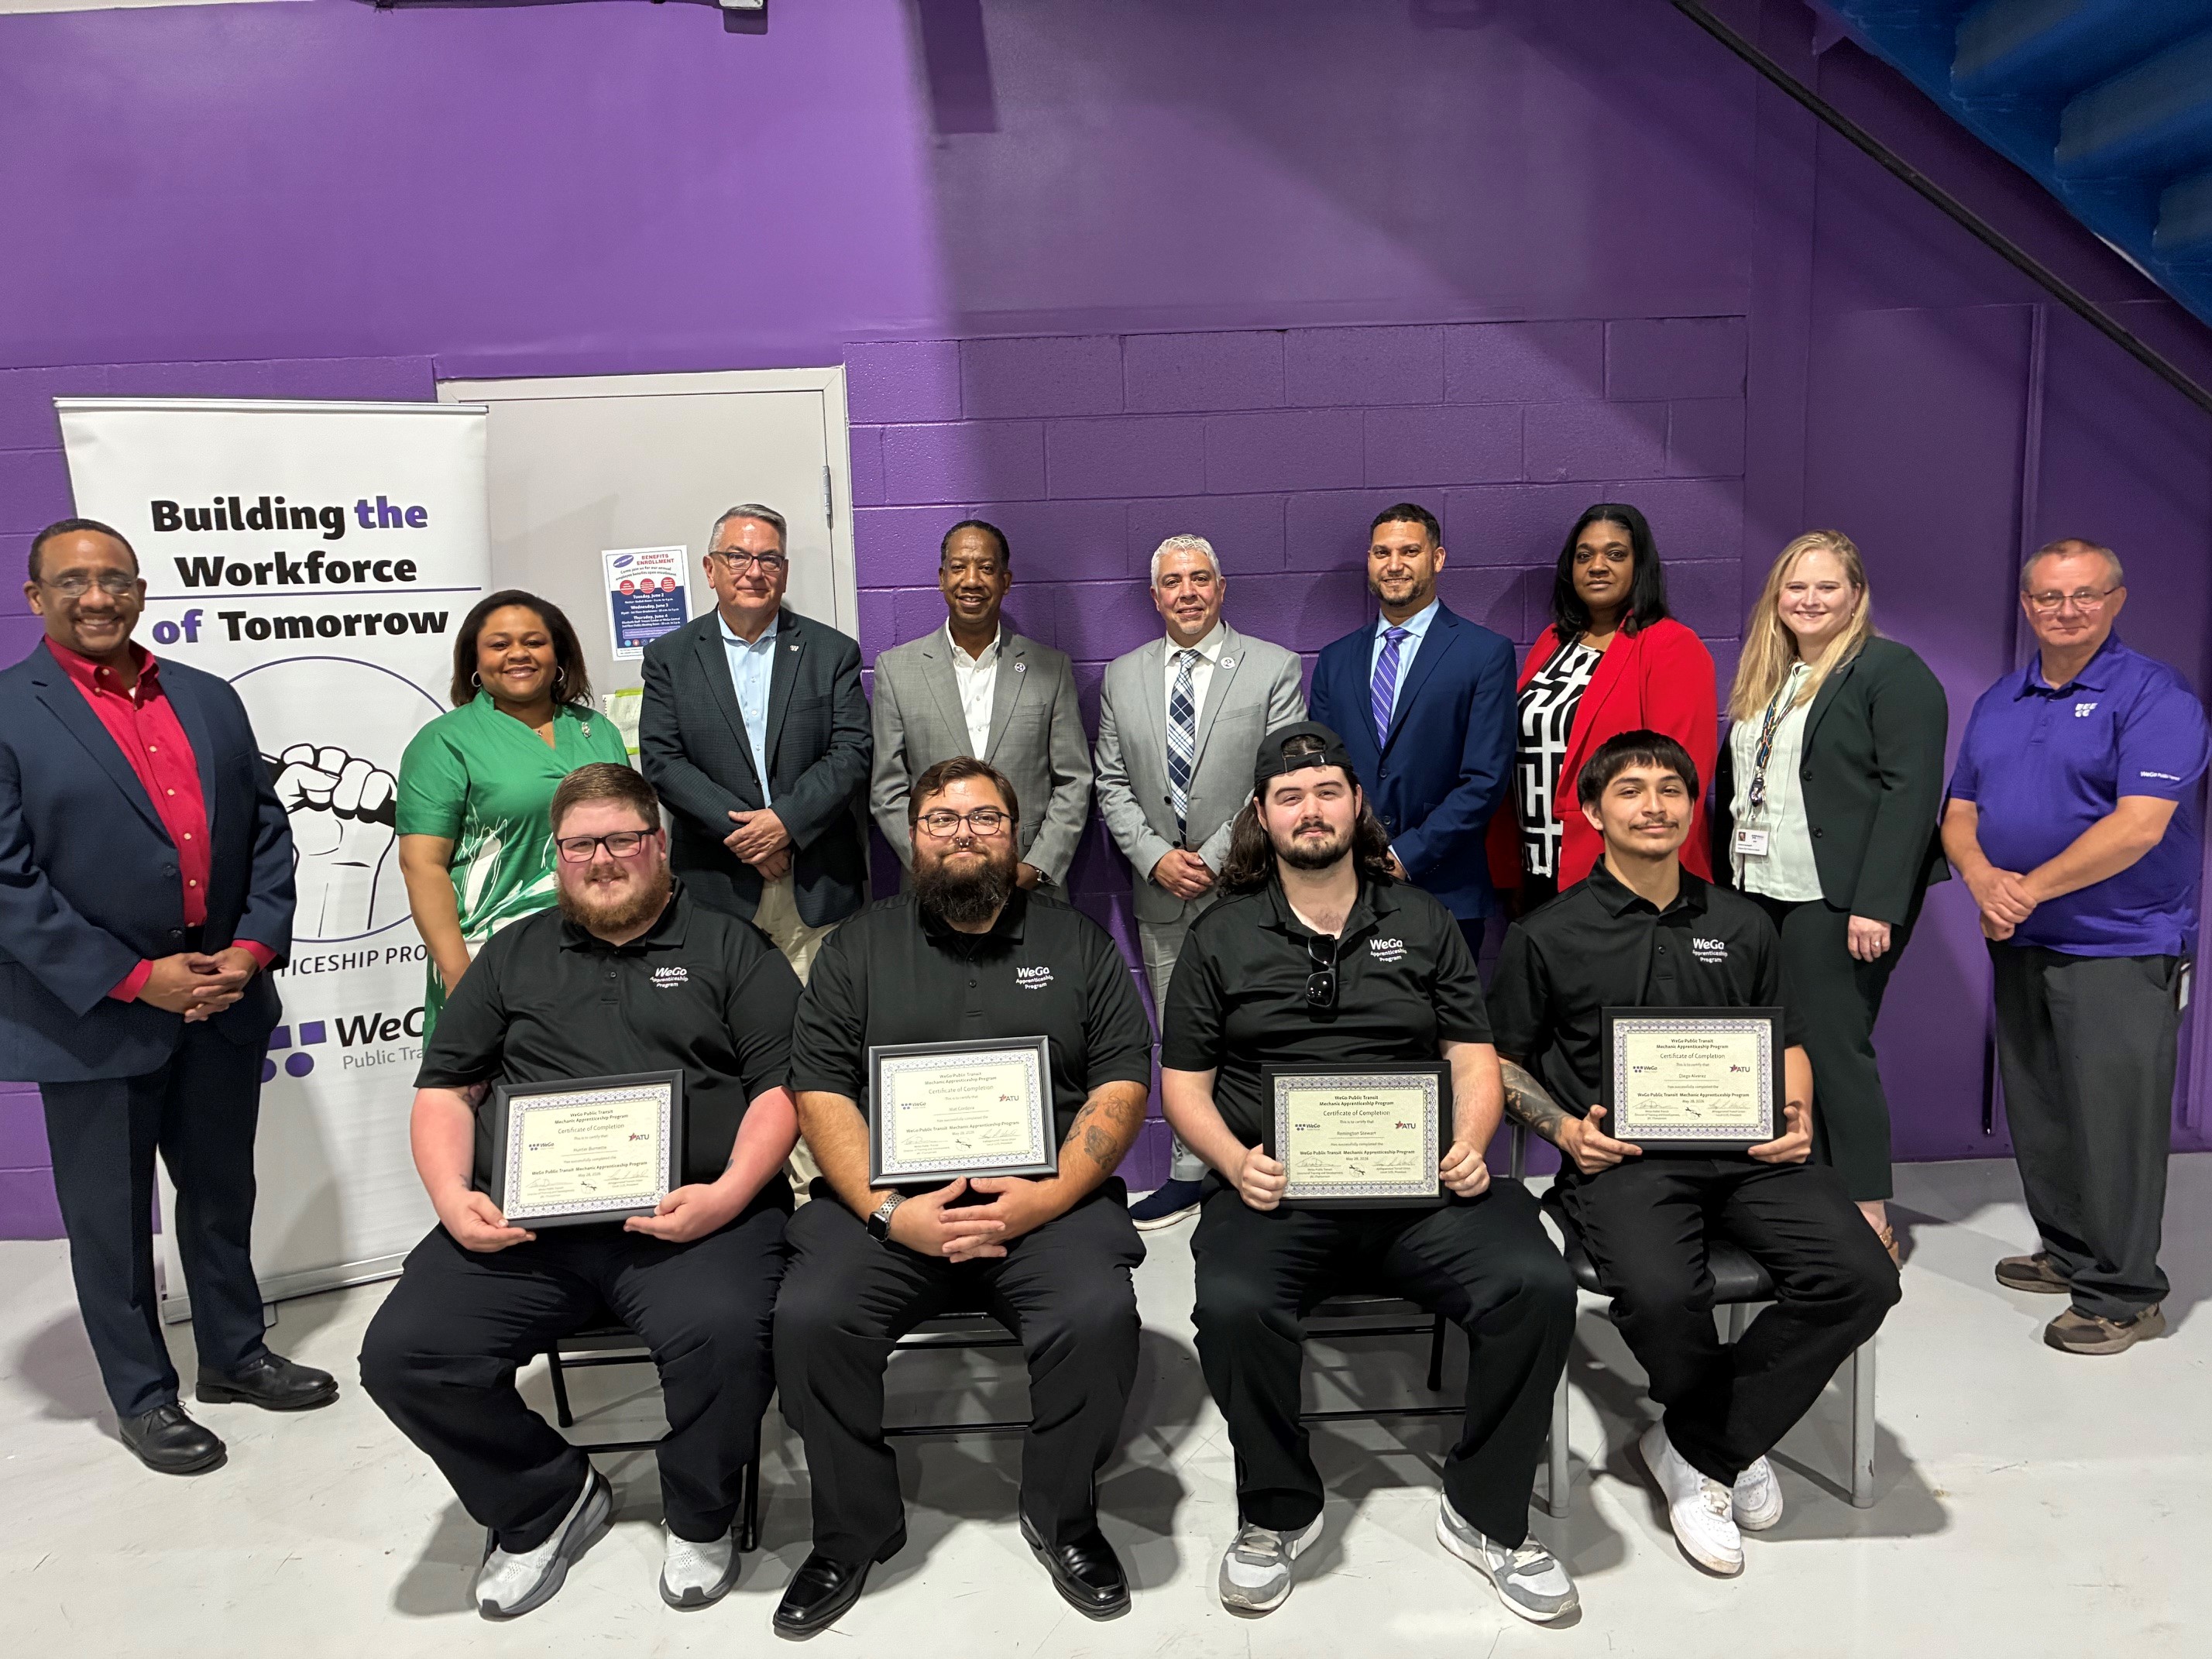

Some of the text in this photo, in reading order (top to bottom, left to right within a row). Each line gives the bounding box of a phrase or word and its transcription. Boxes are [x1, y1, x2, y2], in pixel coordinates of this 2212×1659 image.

[151, 496, 428, 540] Building the
[173, 551, 417, 587] Workforce
[153, 609, 448, 644] of Tomorrow
[1370, 938, 1403, 950] WeGo
[1693, 938, 1724, 950] WeGo
[655, 967, 687, 977] WeGo
[1016, 967, 1049, 977] WeGo
[343, 1049, 395, 1070] Public
